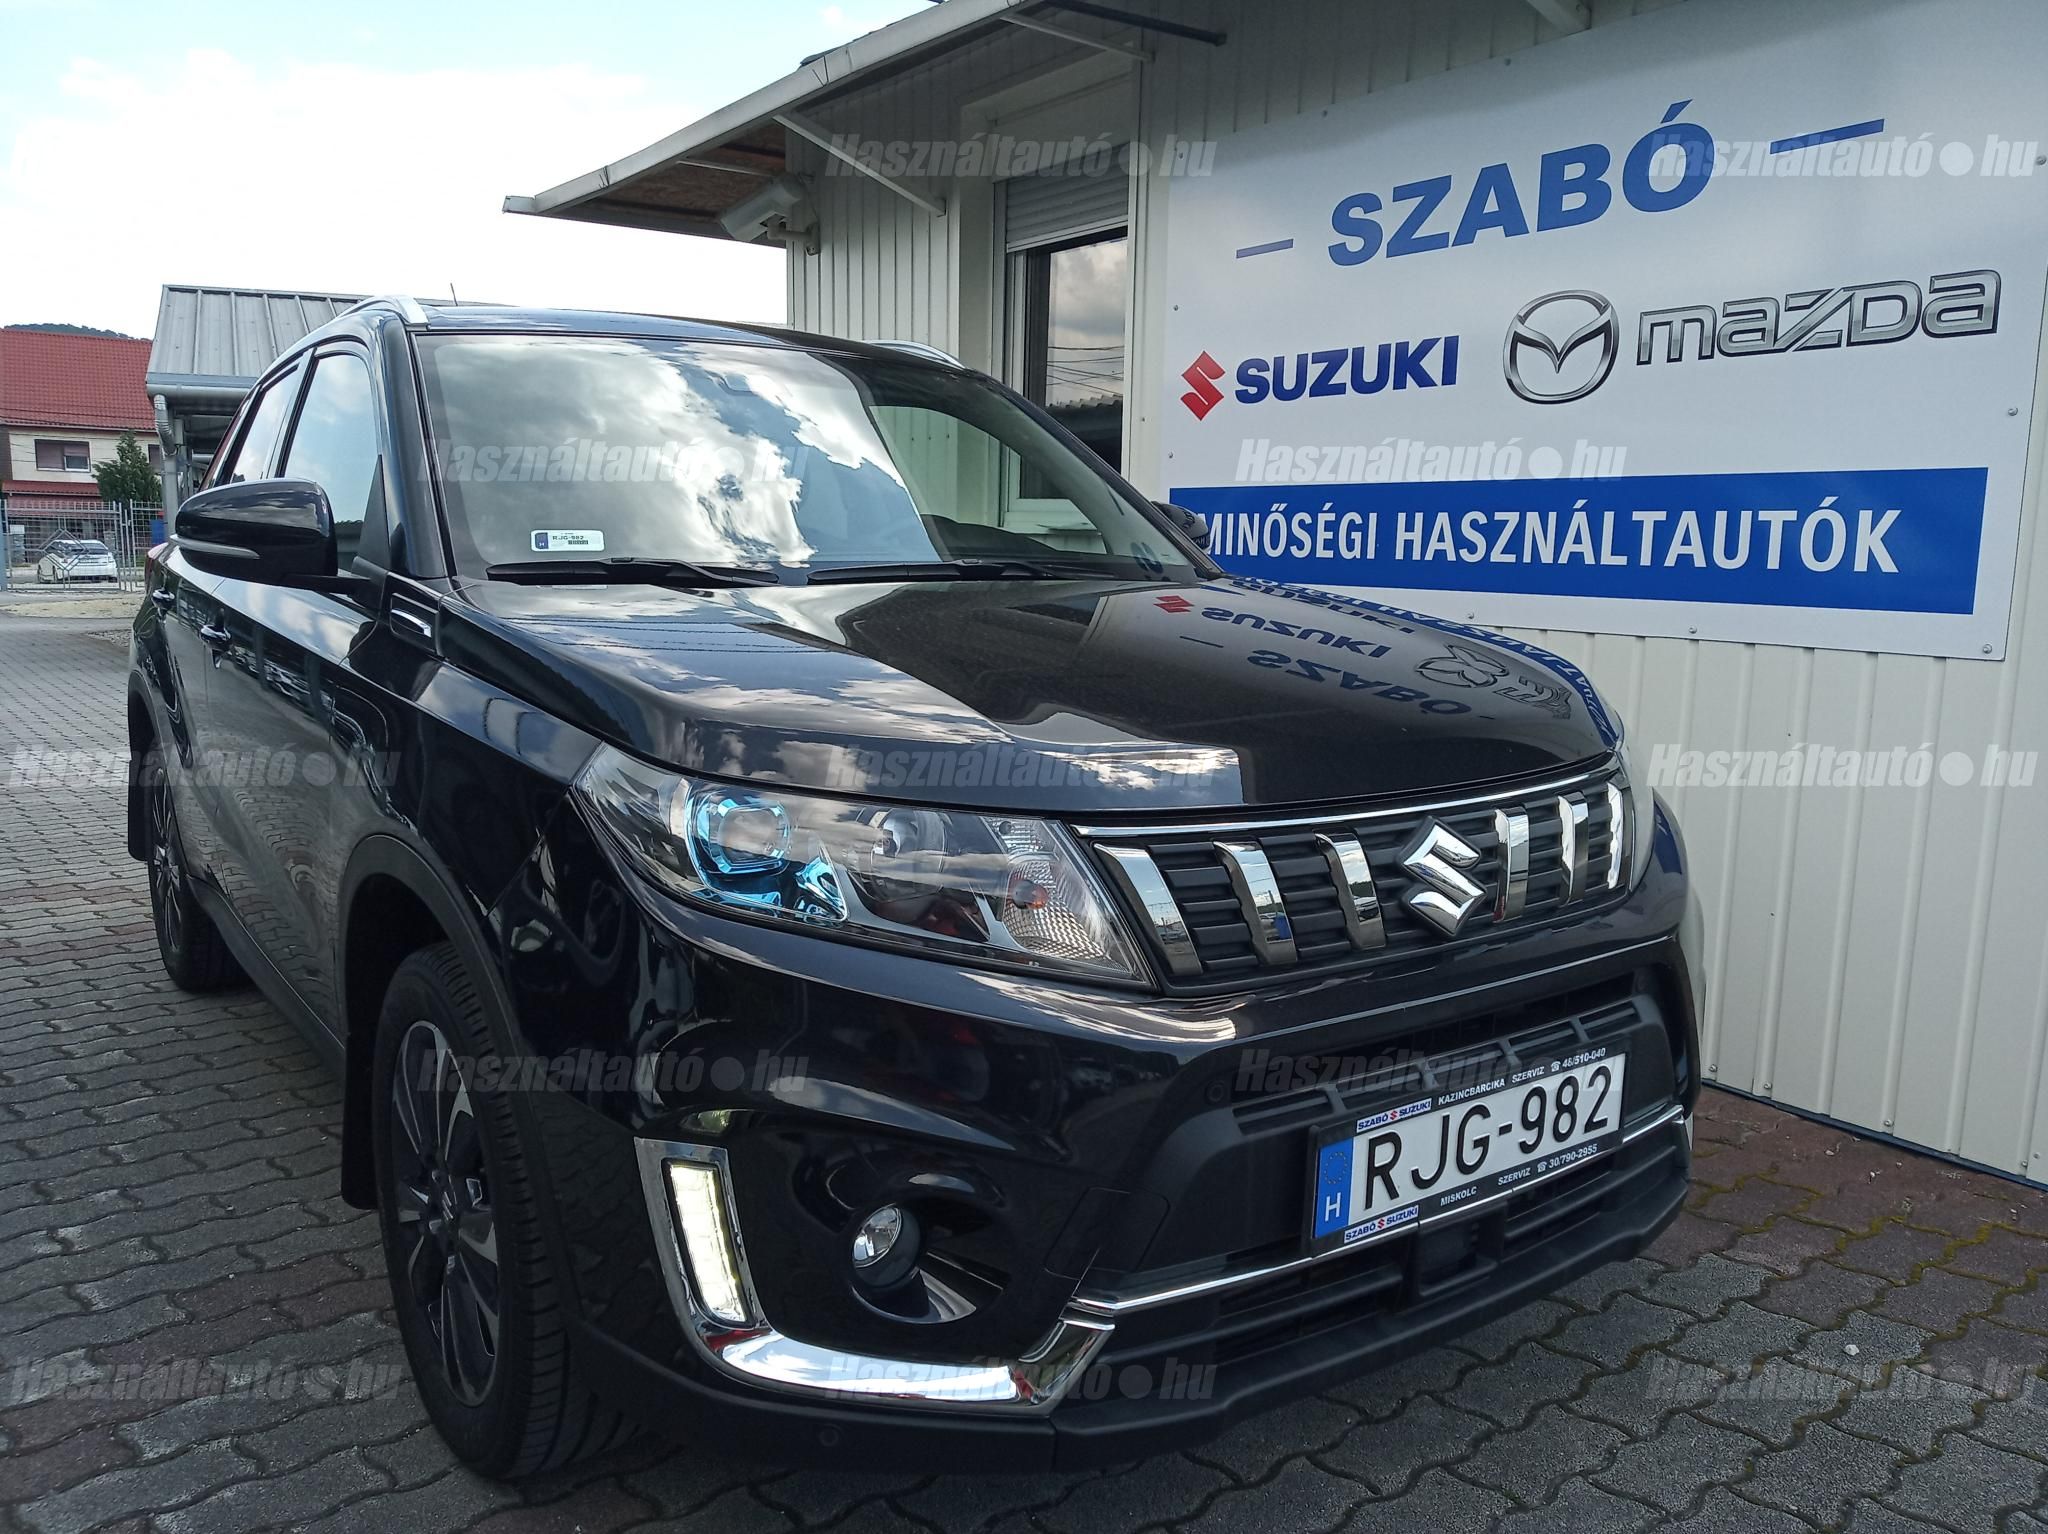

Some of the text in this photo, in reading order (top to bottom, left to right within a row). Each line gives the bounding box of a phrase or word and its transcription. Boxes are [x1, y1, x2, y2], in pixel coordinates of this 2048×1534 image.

[1328, 99, 1715, 267] SZABÓ
[1234, 335, 1460, 404] SUZUKI
[1198, 503, 1378, 560] MINŐSÉGI
[1395, 496, 1902, 573] HASZNÁLTAUTÓK
[1357, 1114, 1389, 1130] SZABÓ
[1399, 1101, 1431, 1117] SUZUKI
[1438, 1078, 1506, 1106] KAZINCBARCIKA
[1512, 1066, 1545, 1083] SZERVIZ
[1364, 1064, 1612, 1211] RJG-982
[1324, 1192, 1342, 1222] H
[1344, 1222, 1376, 1242] SZABÓ
[1386, 1206, 1419, 1225] SUZUKI
[1440, 1186, 1478, 1207] MISKOLC
[1498, 1167, 1532, 1186] SZERVIZ
